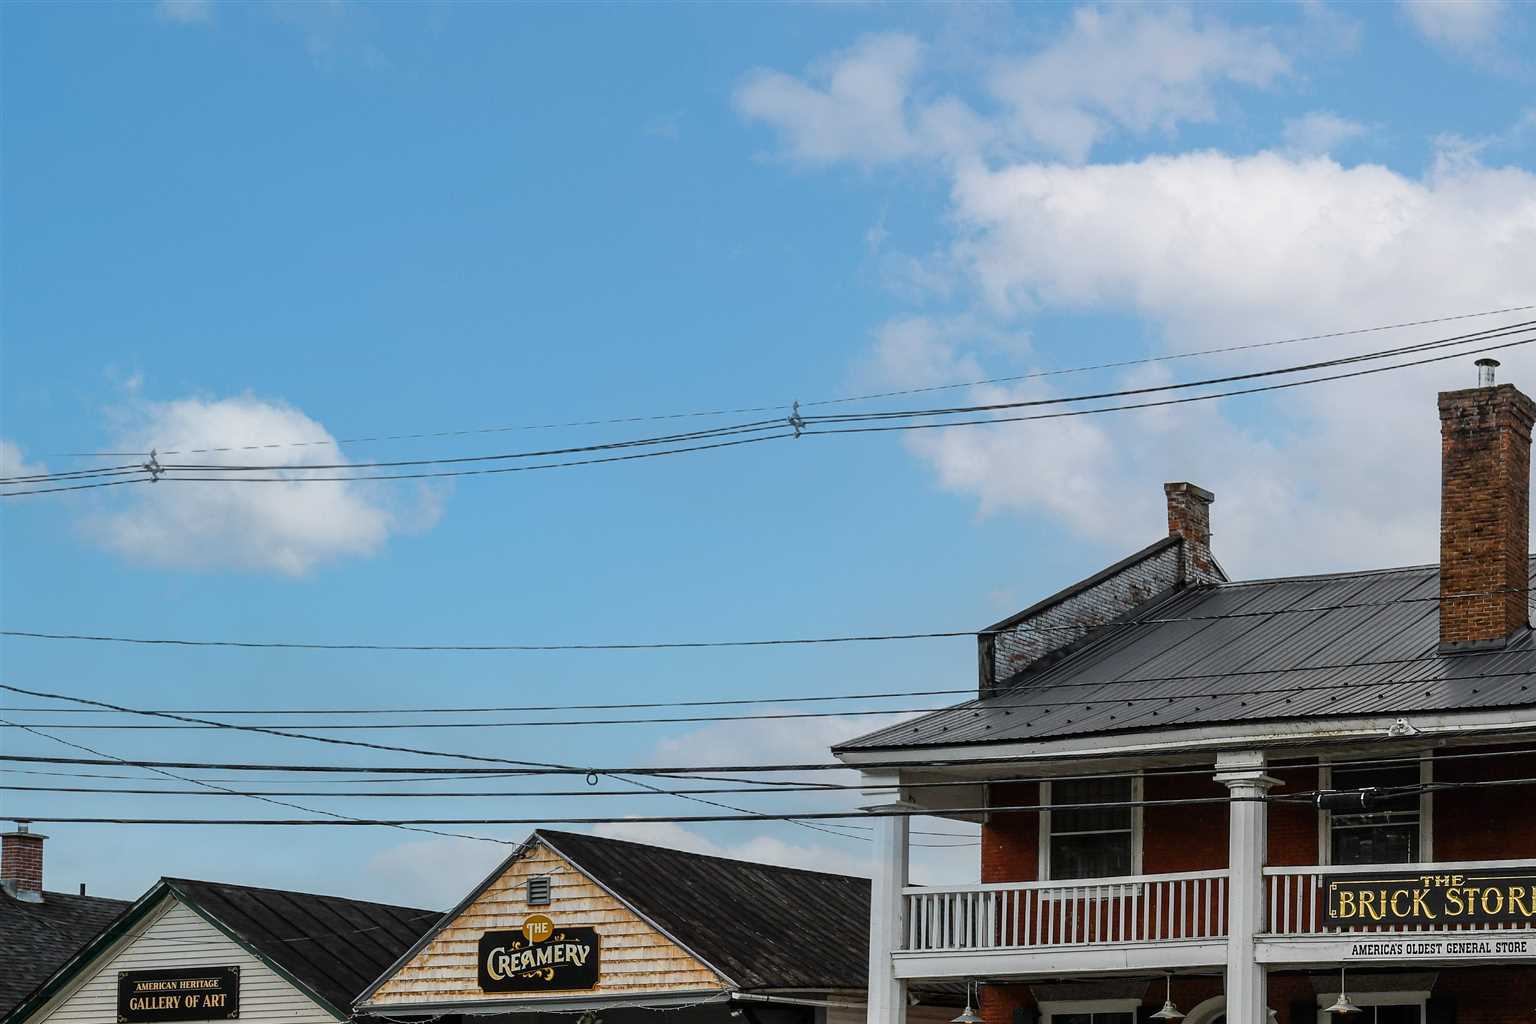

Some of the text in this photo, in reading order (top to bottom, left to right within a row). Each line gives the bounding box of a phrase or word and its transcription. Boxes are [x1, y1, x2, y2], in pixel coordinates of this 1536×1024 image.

[1420, 875, 1466, 887] THE
[1339, 888, 1437, 920] BRICK
[527, 922, 549, 947] THE
[1351, 941, 1527, 955] AMERICA'S OLDEST GENERAL STORE
[487, 944, 591, 981] CREAMERY
[136, 980, 220, 991] AMERICAN HERITAGE
[129, 994, 227, 1011] GALLERY OF ART
